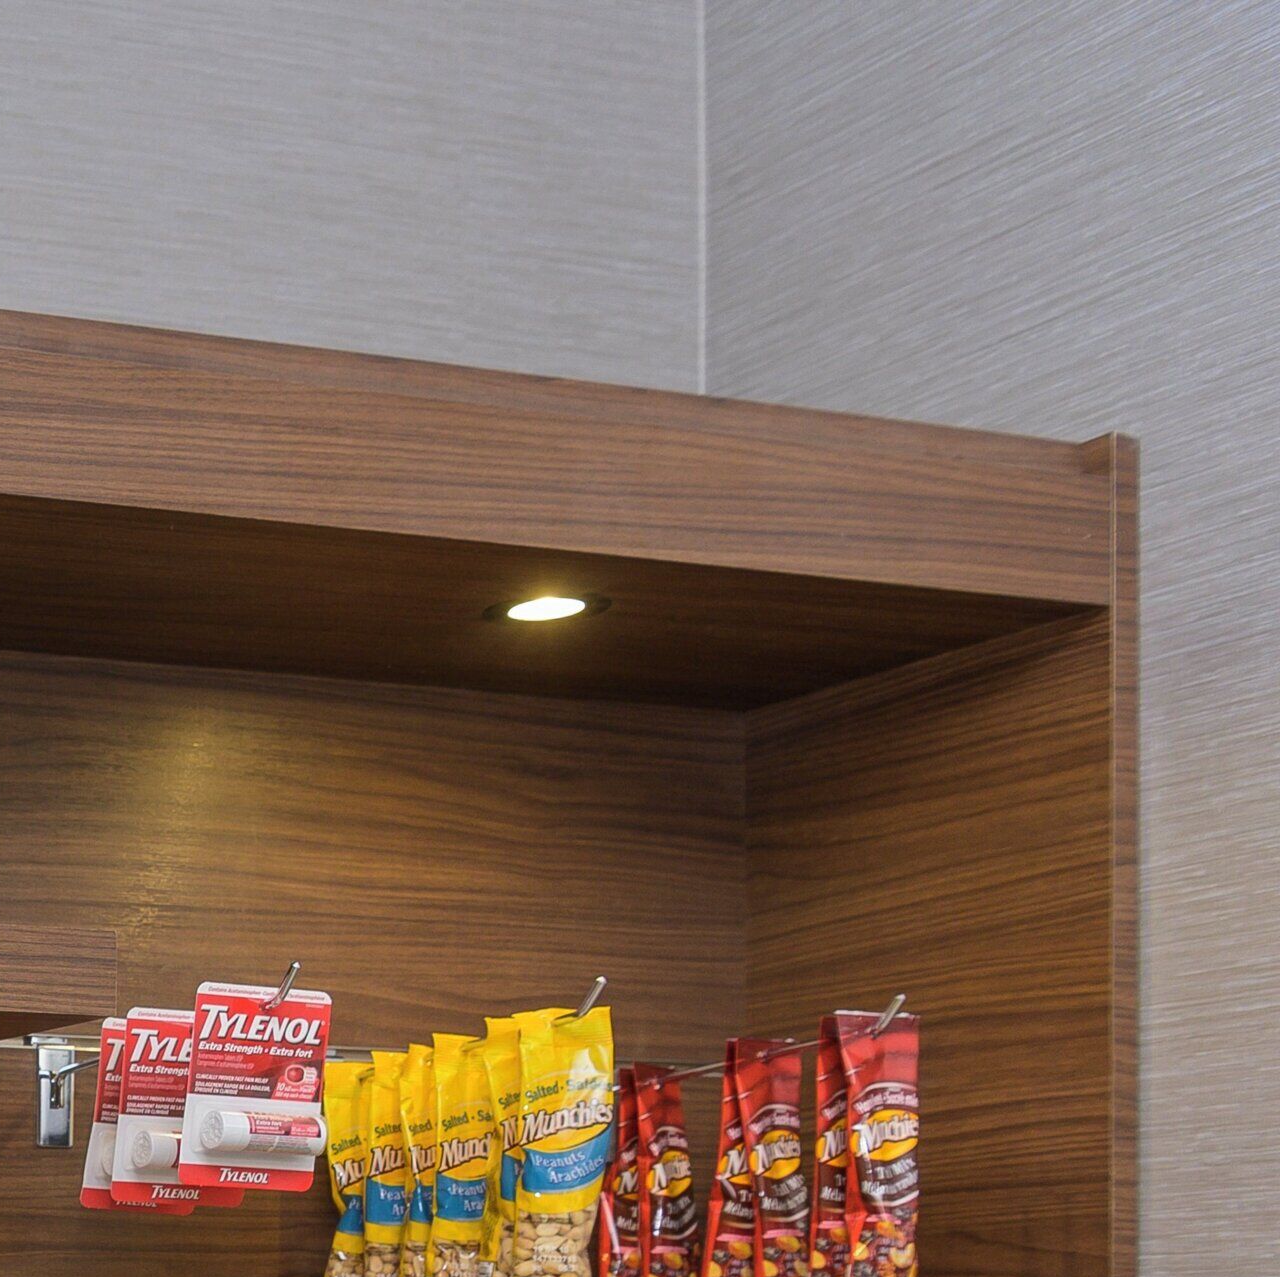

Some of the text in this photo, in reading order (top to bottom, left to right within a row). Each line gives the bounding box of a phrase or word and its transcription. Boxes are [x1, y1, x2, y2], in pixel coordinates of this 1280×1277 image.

[199, 1004, 322, 1046] TYLENOL
[524, 1080, 560, 1104] Salted
[521, 1100, 614, 1147] Munchies
